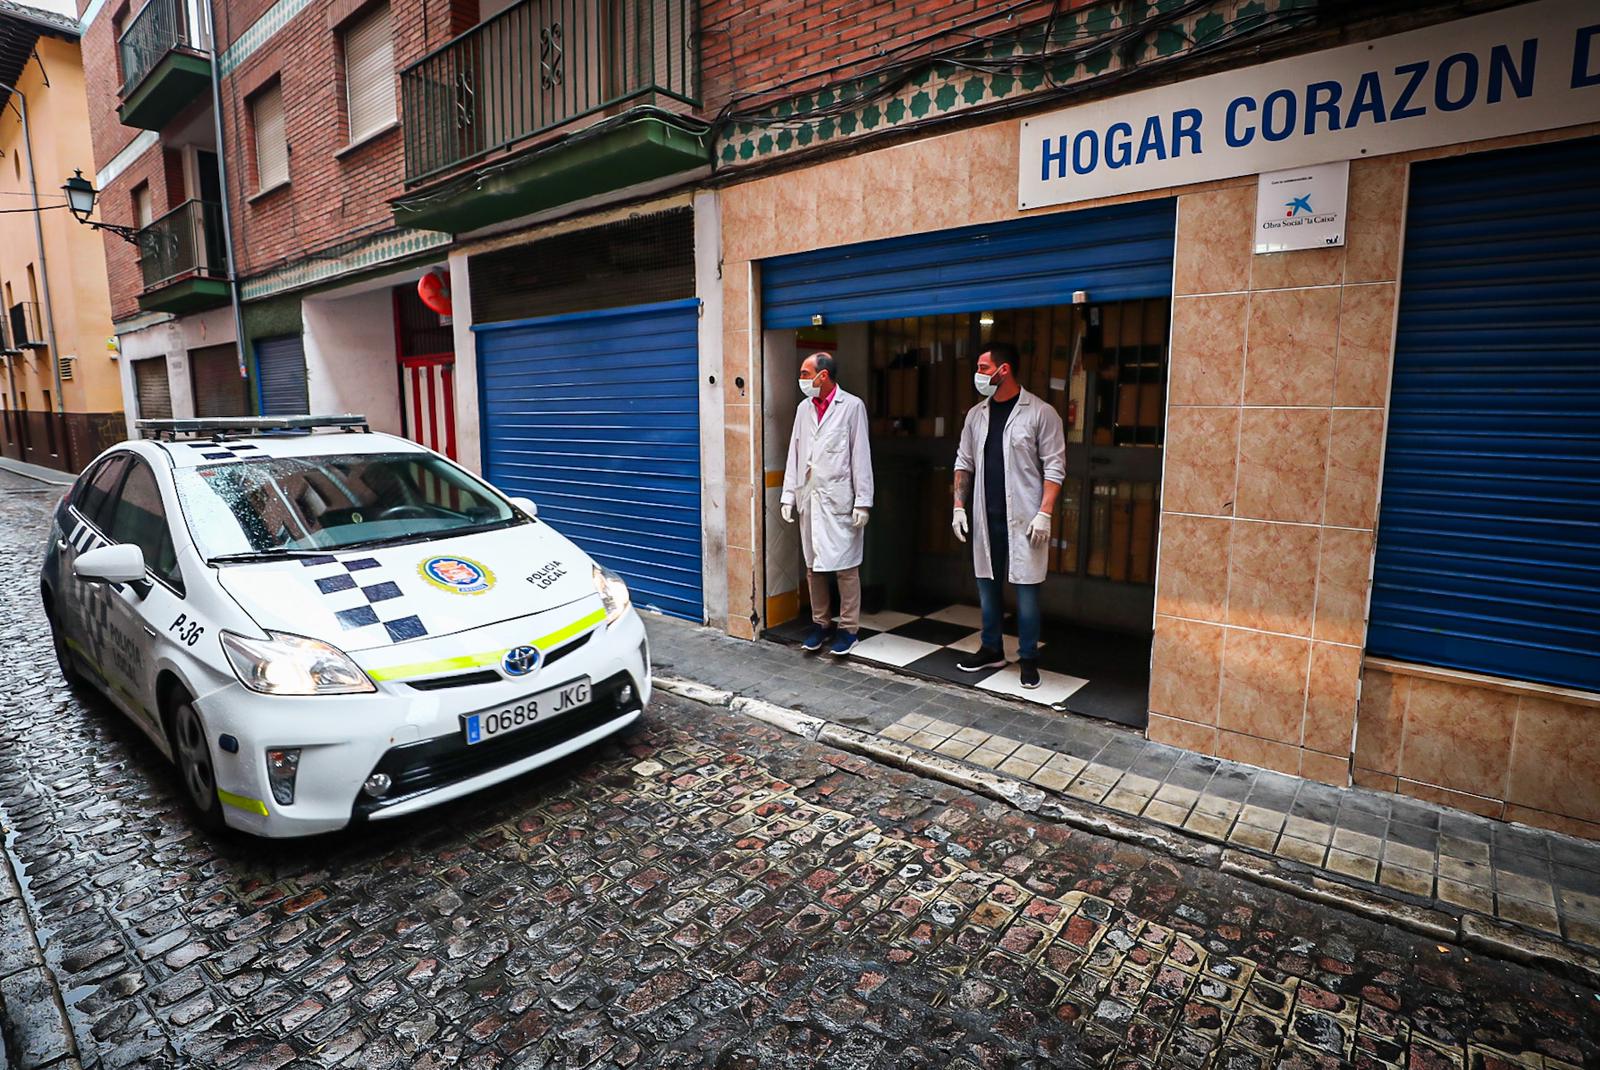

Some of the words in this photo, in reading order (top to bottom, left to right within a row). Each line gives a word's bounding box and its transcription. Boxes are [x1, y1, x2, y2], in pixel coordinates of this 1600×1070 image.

[1041, 107, 1203, 181] HOGAR
[1225, 37, 1539, 149] CORAZON
[1262, 222, 1281, 230] Obra
[1282, 217, 1304, 227] Social
[526, 560, 563, 584] POLICIA
[536, 569, 568, 590] LOCAL
[169, 613, 204, 646] P-36
[485, 701, 539, 735] 0688
[553, 683, 589, 712] JKG
